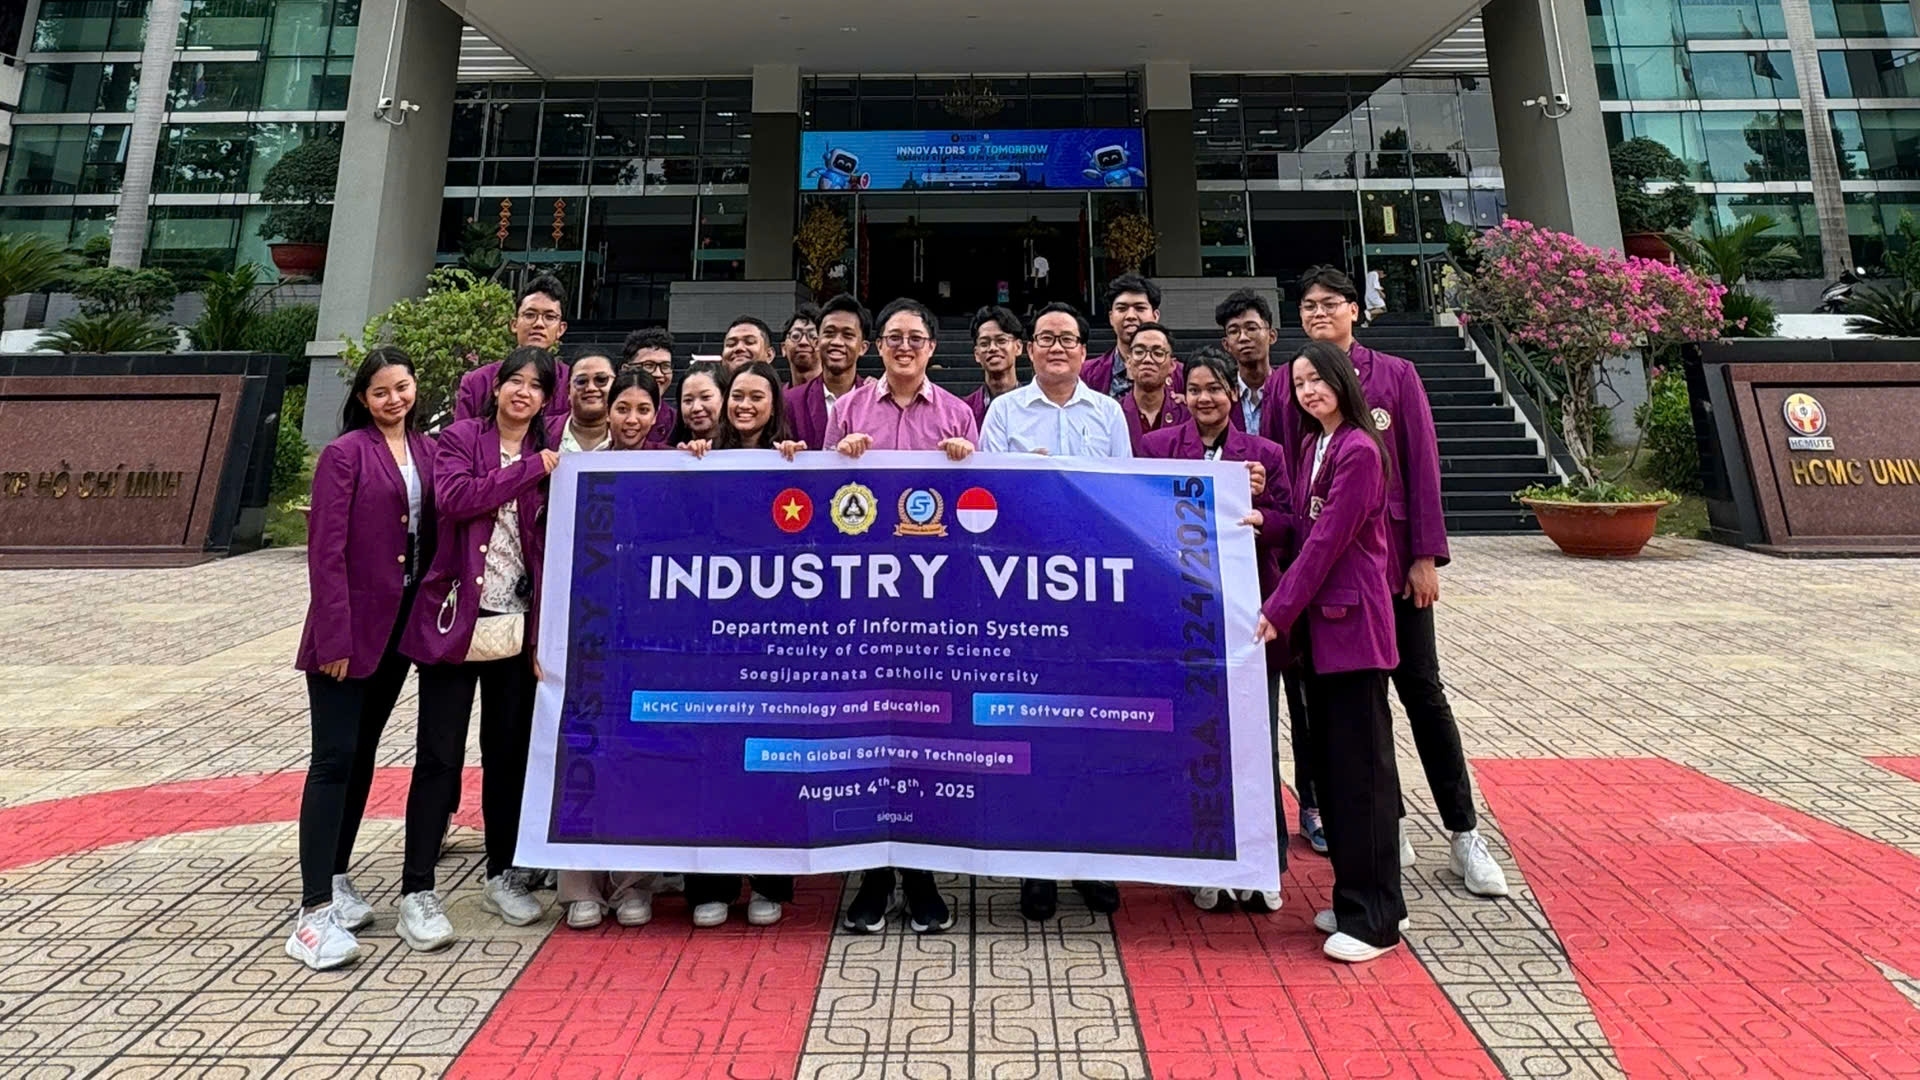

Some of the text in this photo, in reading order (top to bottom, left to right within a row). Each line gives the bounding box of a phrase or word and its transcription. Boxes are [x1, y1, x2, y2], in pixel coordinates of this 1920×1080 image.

[896, 144, 1049, 155] INNOVATORS OF TOMORROW
[1791, 439, 1832, 448] HCMUTE
[1791, 458, 1864, 485] HCMC
[650, 553, 1134, 602] INDUSTRY VISIT
[1173, 476, 1219, 697] 2024/2025
[712, 617, 1069, 639] Department of Information Systems
[767, 643, 1012, 658] Faculty of Computer Science
[740, 667, 1039, 685] Soegijapranata Catholic University
[642, 699, 941, 717] HCMC University Technology and Education
[990, 704, 1155, 723] FPT Software Company
[761, 745, 1014, 766] Bosch Global Software Technologies
[799, 782, 861, 801] August
[935, 782, 975, 798] 2025
[877, 811, 913, 824] siega.id
